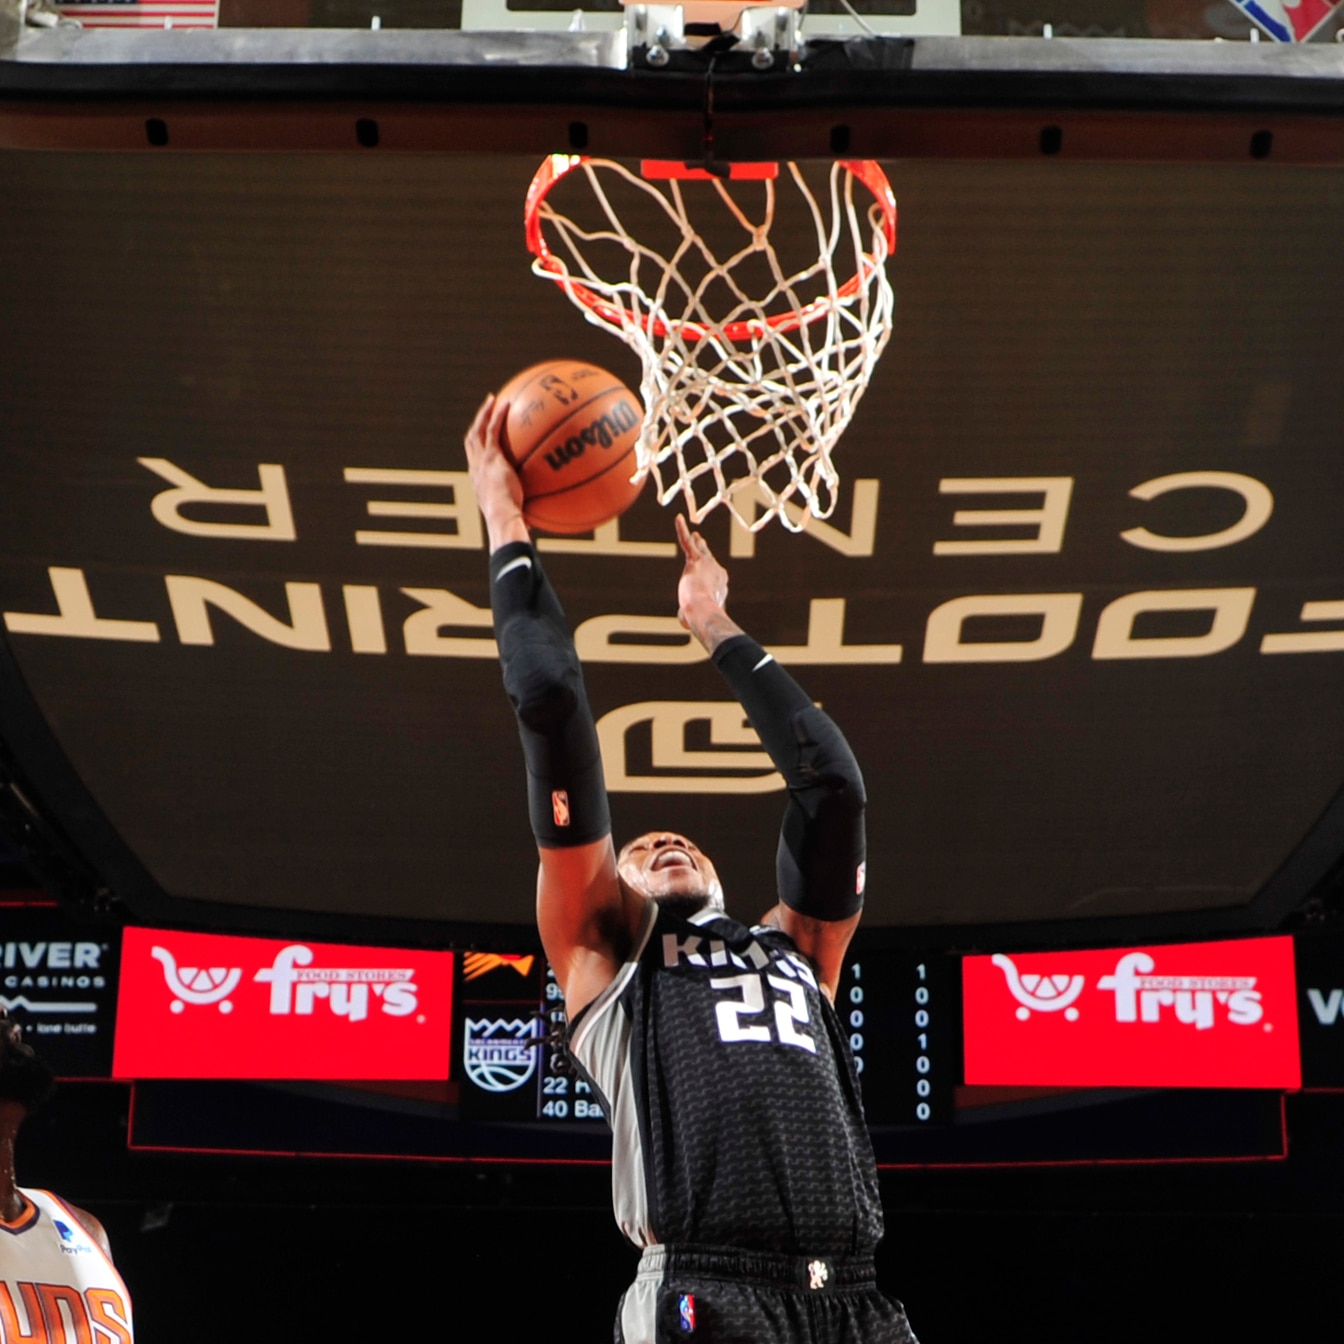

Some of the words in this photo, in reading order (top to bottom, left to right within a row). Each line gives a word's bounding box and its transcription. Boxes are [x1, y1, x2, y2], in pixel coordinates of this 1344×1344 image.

[544, 400, 639, 471] Wilson
[137, 457, 1274, 557] CENTER
[5, 976, 105, 988] CASINOS
[254, 945, 418, 1022] fry's
[297, 970, 339, 981] FOOD
[1096, 952, 1264, 1030] fry's
[710, 974, 817, 1054] 22
[468, 1047, 532, 1062] KINGS
[543, 1077, 568, 1094] 22
[543, 1100, 568, 1118] 40
